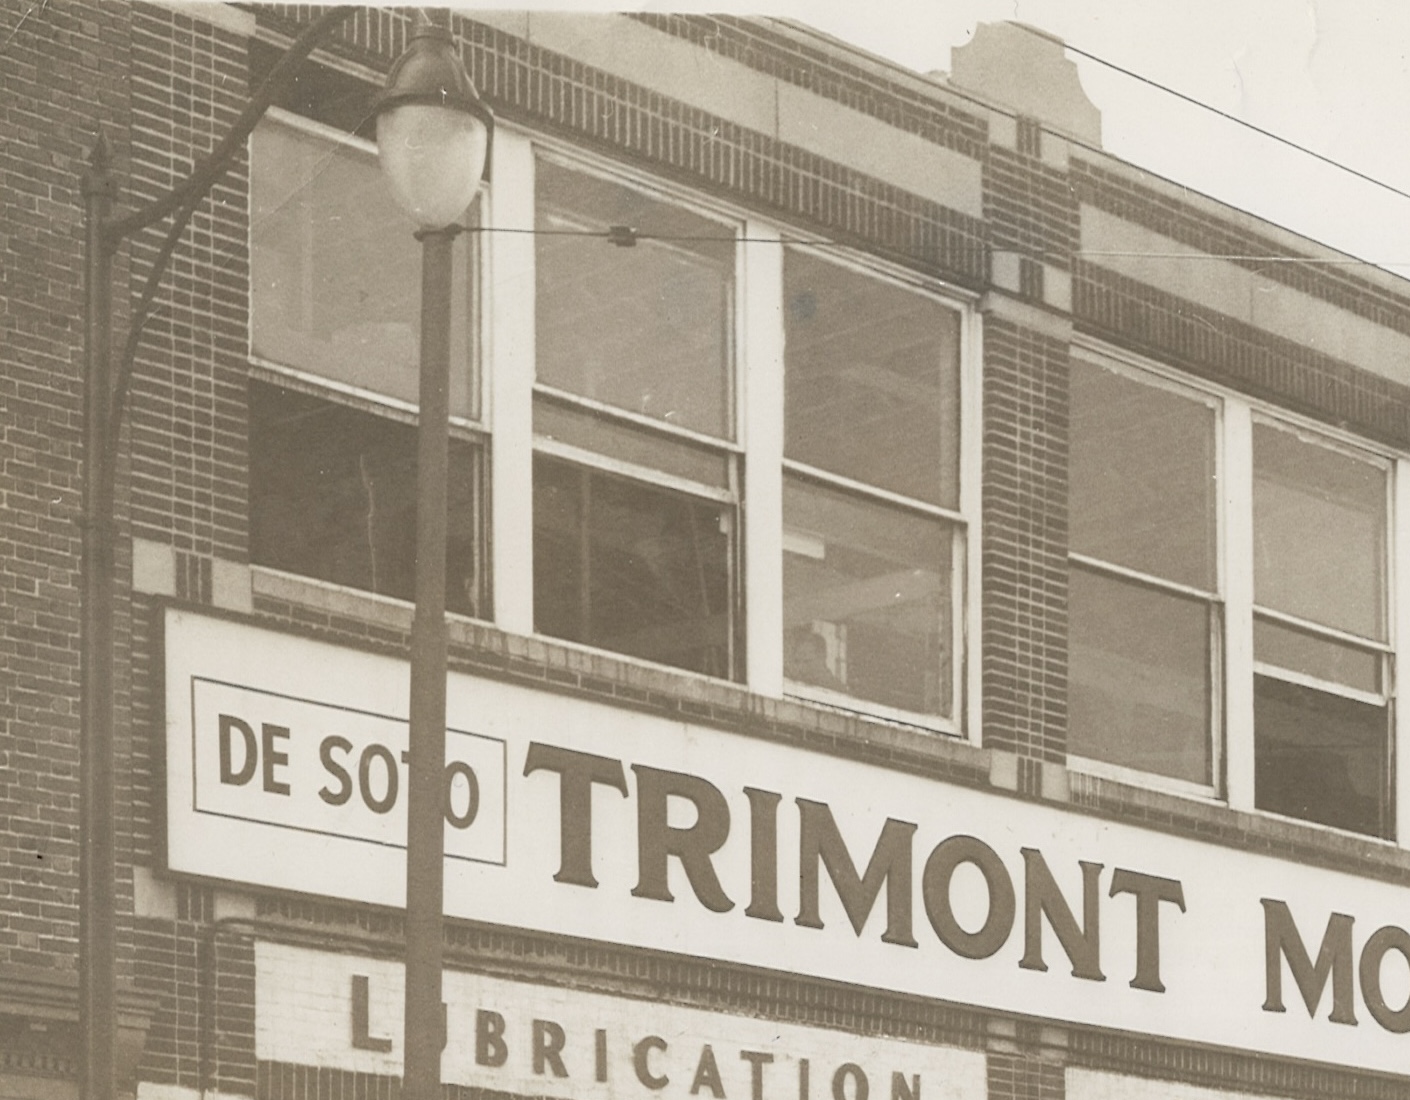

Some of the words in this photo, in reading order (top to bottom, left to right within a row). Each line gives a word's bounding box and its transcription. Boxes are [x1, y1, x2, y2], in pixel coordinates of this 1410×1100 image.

[218, 713, 292, 797] DE
[318, 735, 480, 831] SOO
[522, 740, 1186, 993] TRIMONT
